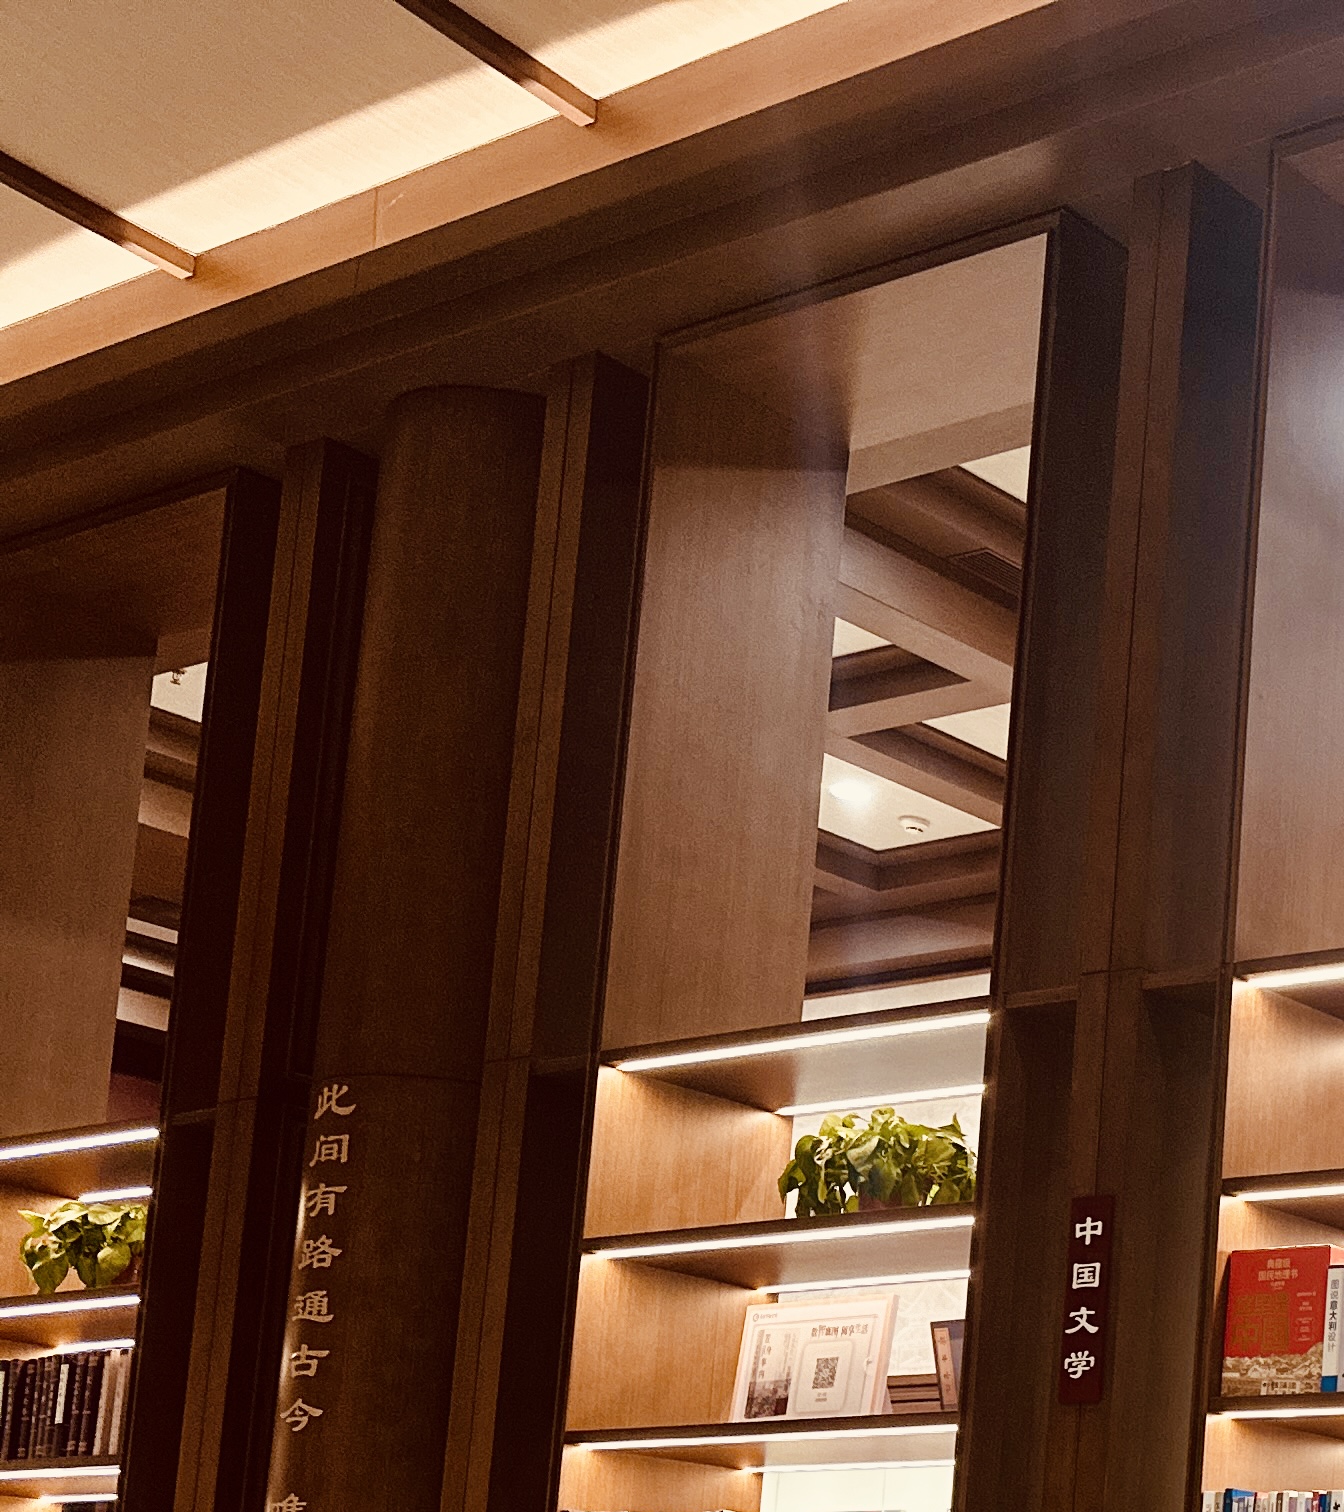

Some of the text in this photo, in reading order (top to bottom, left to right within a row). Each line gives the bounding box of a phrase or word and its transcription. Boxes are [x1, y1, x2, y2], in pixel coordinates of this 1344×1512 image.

[280, 1083, 357, 1433] 此间有路通古今
[1064, 1216, 1103, 1379] 中国文学
